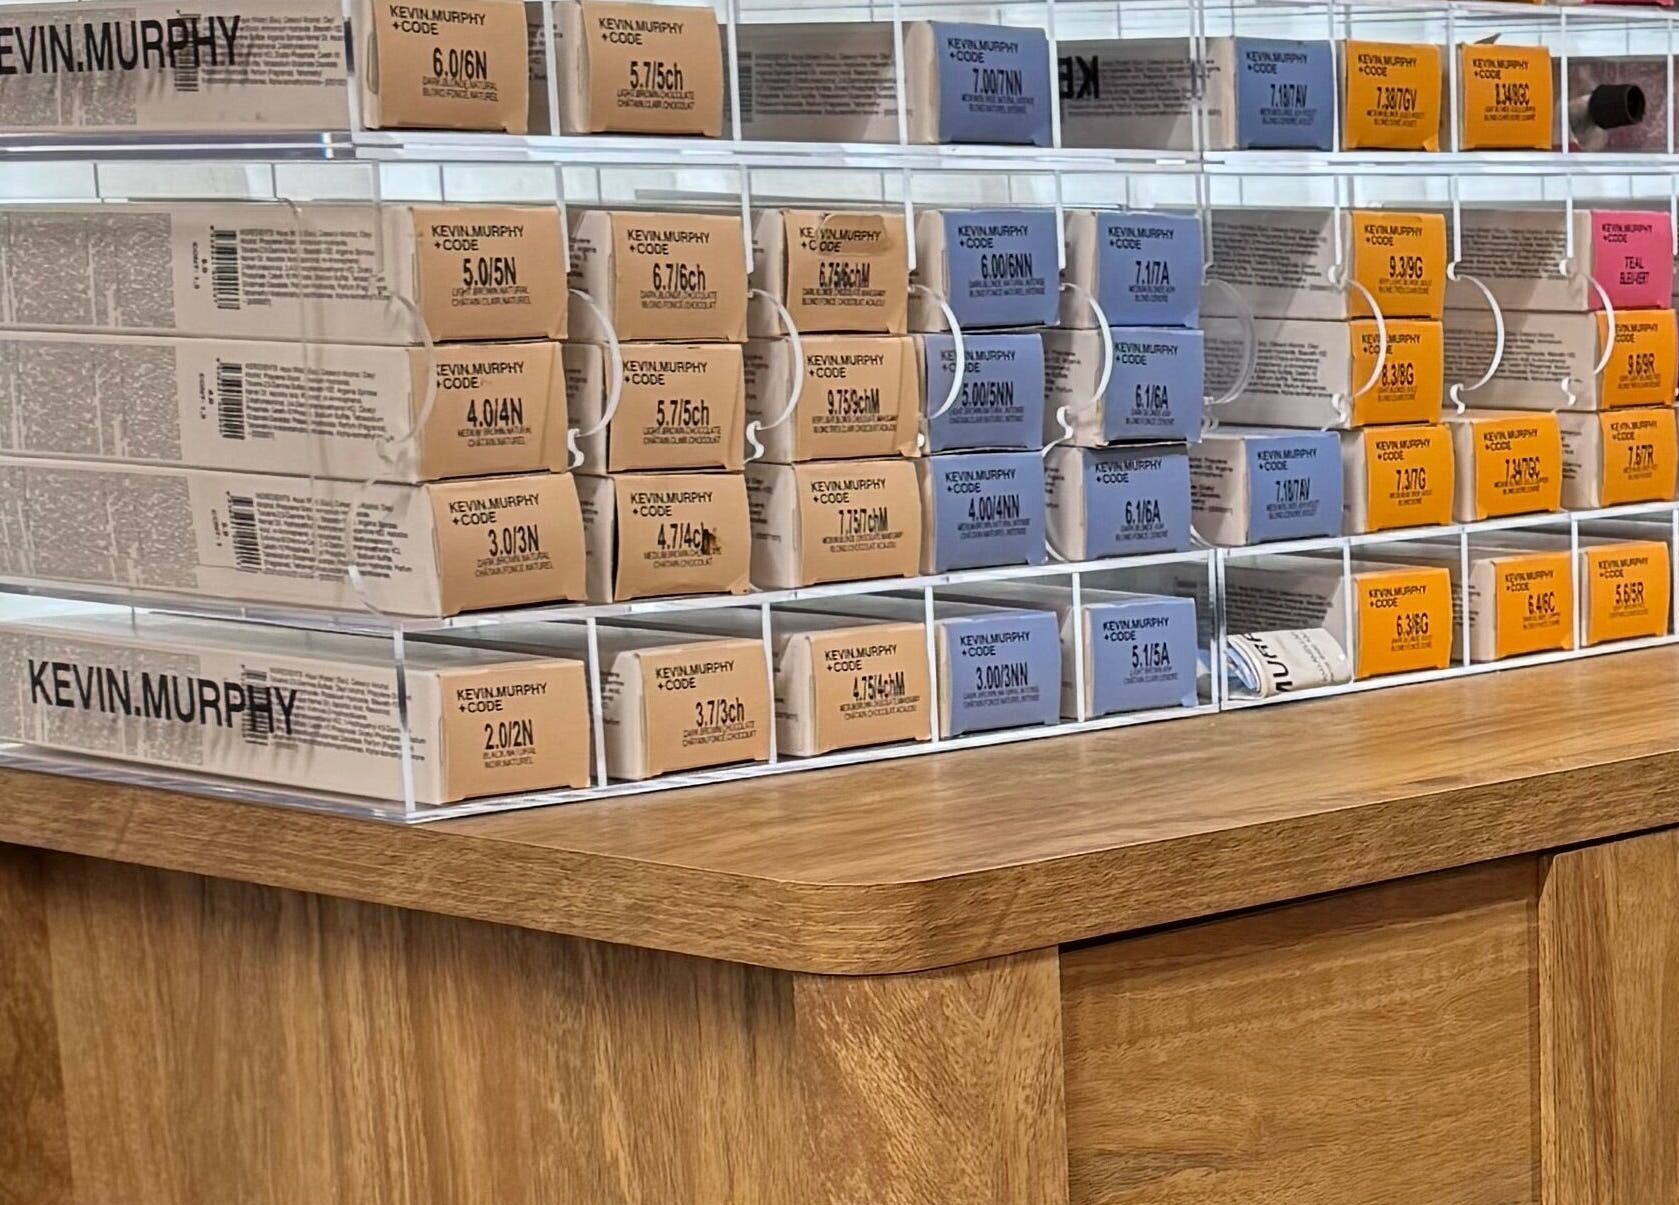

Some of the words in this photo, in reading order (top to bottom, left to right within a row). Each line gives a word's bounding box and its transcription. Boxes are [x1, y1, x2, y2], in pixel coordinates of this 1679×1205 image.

[390, 5, 485, 26] KEVIN.MURPHY
[393, 21, 439, 35] +CODE
[599, 18, 683, 34] KEVIN.MURPHY
[0, 16, 240, 75] EVIN.MURPHY
[602, 32, 643, 45] +CODE
[947, 37, 1019, 54] KEVIN.MURPHY
[433, 48, 487, 79] 6.0/6N
[630, 61, 683, 90] 5.7/5ch
[432, 226, 523, 237] KEVIN.MURPHY
[627, 230, 709, 243] KEVIN.MURPHY
[958, 226, 1028, 239] KEVIN.MURPHY
[1108, 226, 1174, 240] KEVIN.MURPHY
[434, 240, 479, 251] +CODE
[629, 243, 669, 255] +CODE
[960, 239, 994, 249] +CODE
[463, 257, 516, 286] 5.0/5N
[981, 253, 1032, 279] 6.00/6NN
[1135, 260, 1169, 285] 7.1/7A
[653, 263, 705, 291] 6.7/6ch
[623, 361, 707, 372] KEVIN.MURPHY
[807, 355, 884, 366] KEVIN.MURPHY
[625, 374, 665, 385] +CODE
[809, 367, 846, 378] +CODE
[467, 398, 522, 428] 4.0/4N
[656, 399, 709, 428] 5.7/5ch
[1094, 461, 1162, 475] KEVIN.MURPHY
[945, 470, 1016, 483] KEVIN.MURPHY
[1096, 473, 1129, 484] +CODE
[810, 479, 885, 493] KEVIN.MURPHY
[947, 482, 981, 494] +CODE
[449, 494, 539, 514] KEVIN.MURPHY
[631, 492, 712, 504] KEVIN.MURPHY
[813, 491, 850, 504] +CODE
[633, 506, 672, 516] +CODE
[968, 496, 1020, 521] 4.00/4NN
[1125, 500, 1161, 524] 6.1/6A
[452, 512, 496, 525] +CODE
[488, 525, 539, 556] 3.0/3N
[1103, 617, 1170, 632] KEVIN.MURPHY
[959, 632, 1030, 646] KEVIN.MURPHY
[1104, 630, 1136, 642] +CODE
[825, 644, 897, 662] KEVIN.MURPHY
[961, 644, 996, 657] +CODE
[1131, 643, 1170, 669] 5.1/5A
[656, 661, 735, 679] KEVIN.MURPHY
[827, 660, 862, 672] +CODE
[976, 662, 1028, 690] 3.00/3NN
[657, 678, 696, 690] +CODE
[28, 659, 297, 735] KEVIN.MURPHY
[456, 682, 548, 701] KEVIN.MURPHY
[459, 699, 503, 713] +CODE
[695, 699, 745, 728] 3.7/3ch
[485, 720, 533, 749] 2.0/2N
